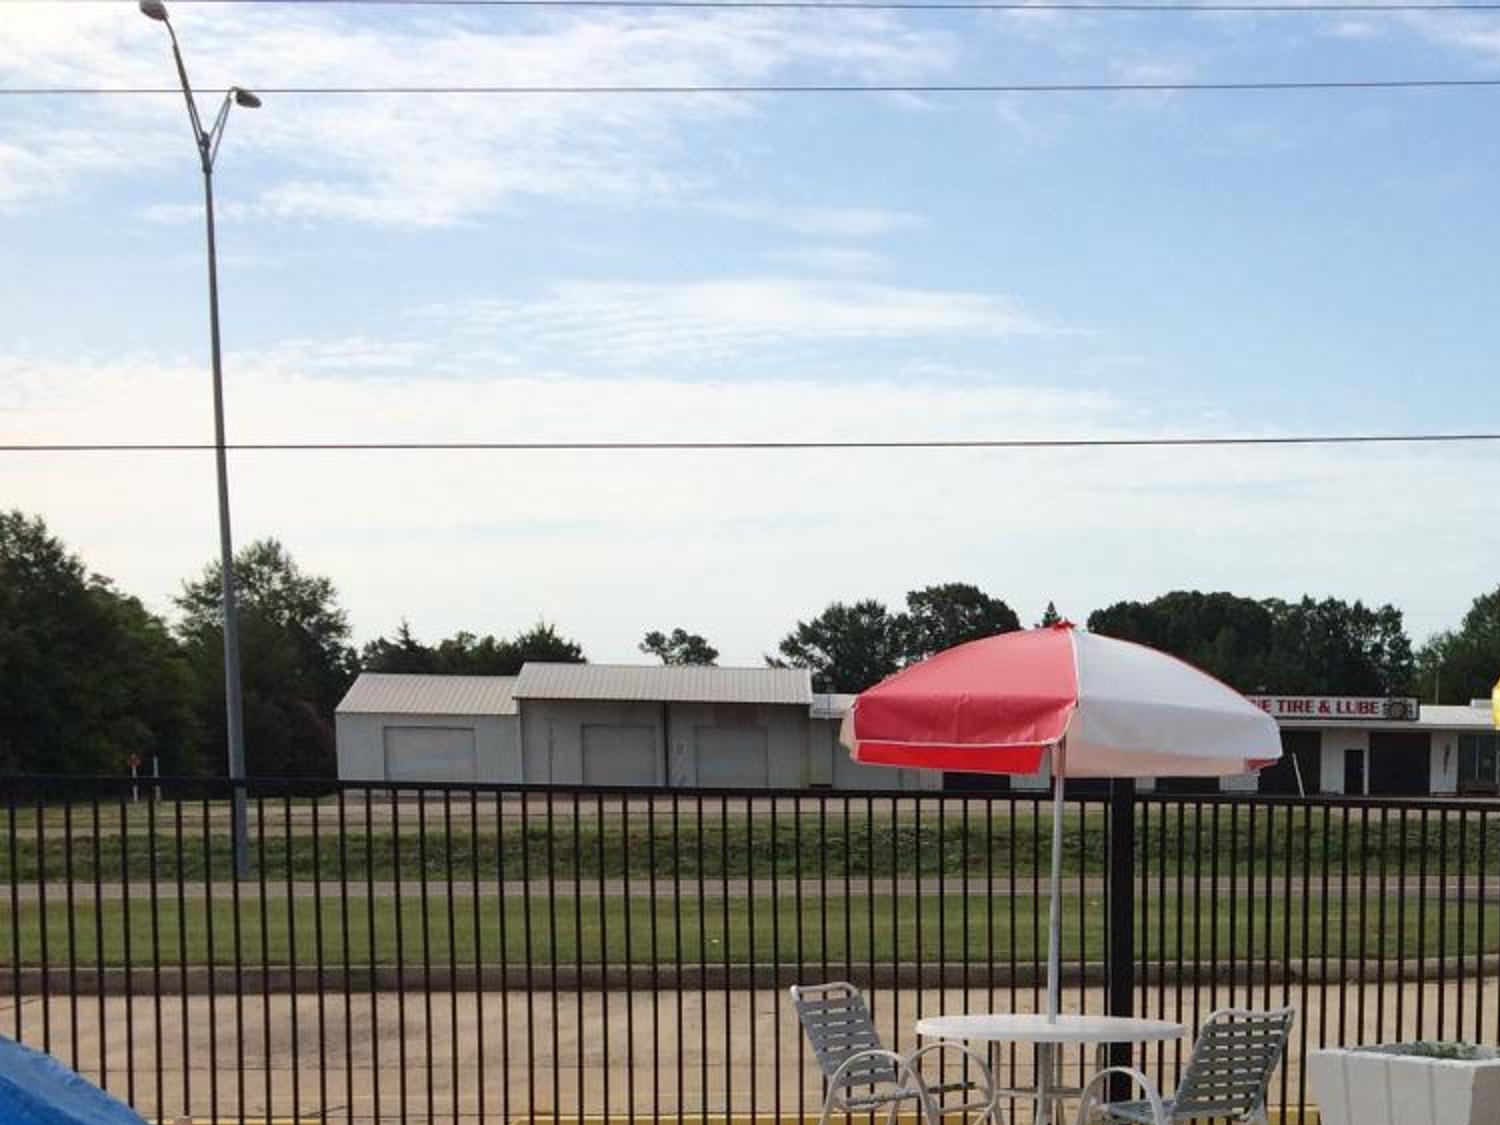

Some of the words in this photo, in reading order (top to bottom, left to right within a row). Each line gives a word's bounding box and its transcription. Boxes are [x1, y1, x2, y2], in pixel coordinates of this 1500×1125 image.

[1278, 699, 1312, 713] TIRE
[1318, 701, 1330, 713] &
[1337, 700, 1377, 714] LUBE
